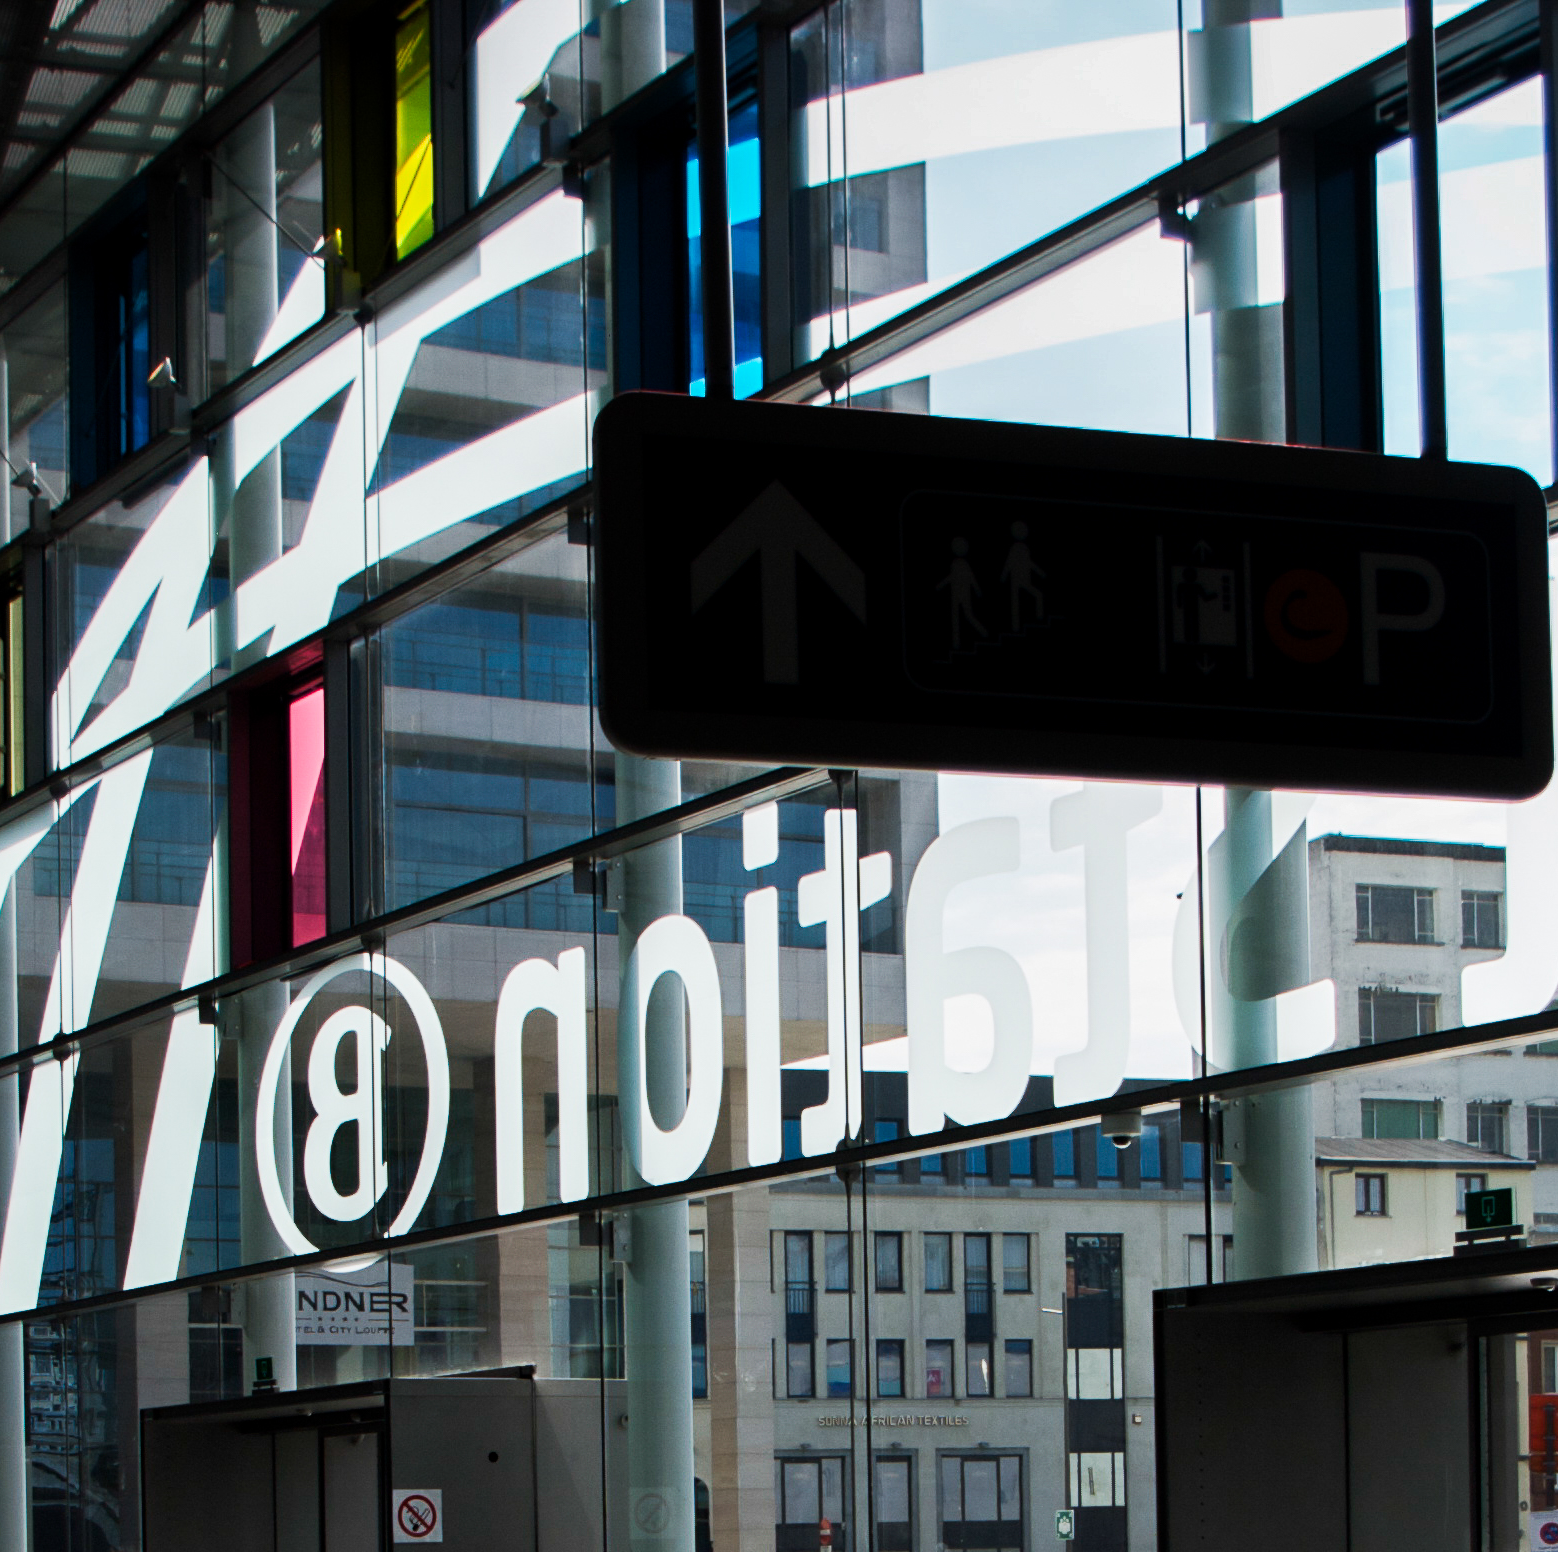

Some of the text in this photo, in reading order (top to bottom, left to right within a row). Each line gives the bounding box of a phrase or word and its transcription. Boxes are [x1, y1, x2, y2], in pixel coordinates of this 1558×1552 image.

[1357, 549, 1447, 686] P
[298, 1290, 409, 1313] NDNER
[297, 1326, 316, 1334] TEL
[329, 1325, 352, 1334] CITY
[918, 1414, 970, 1426] TEXTILES
